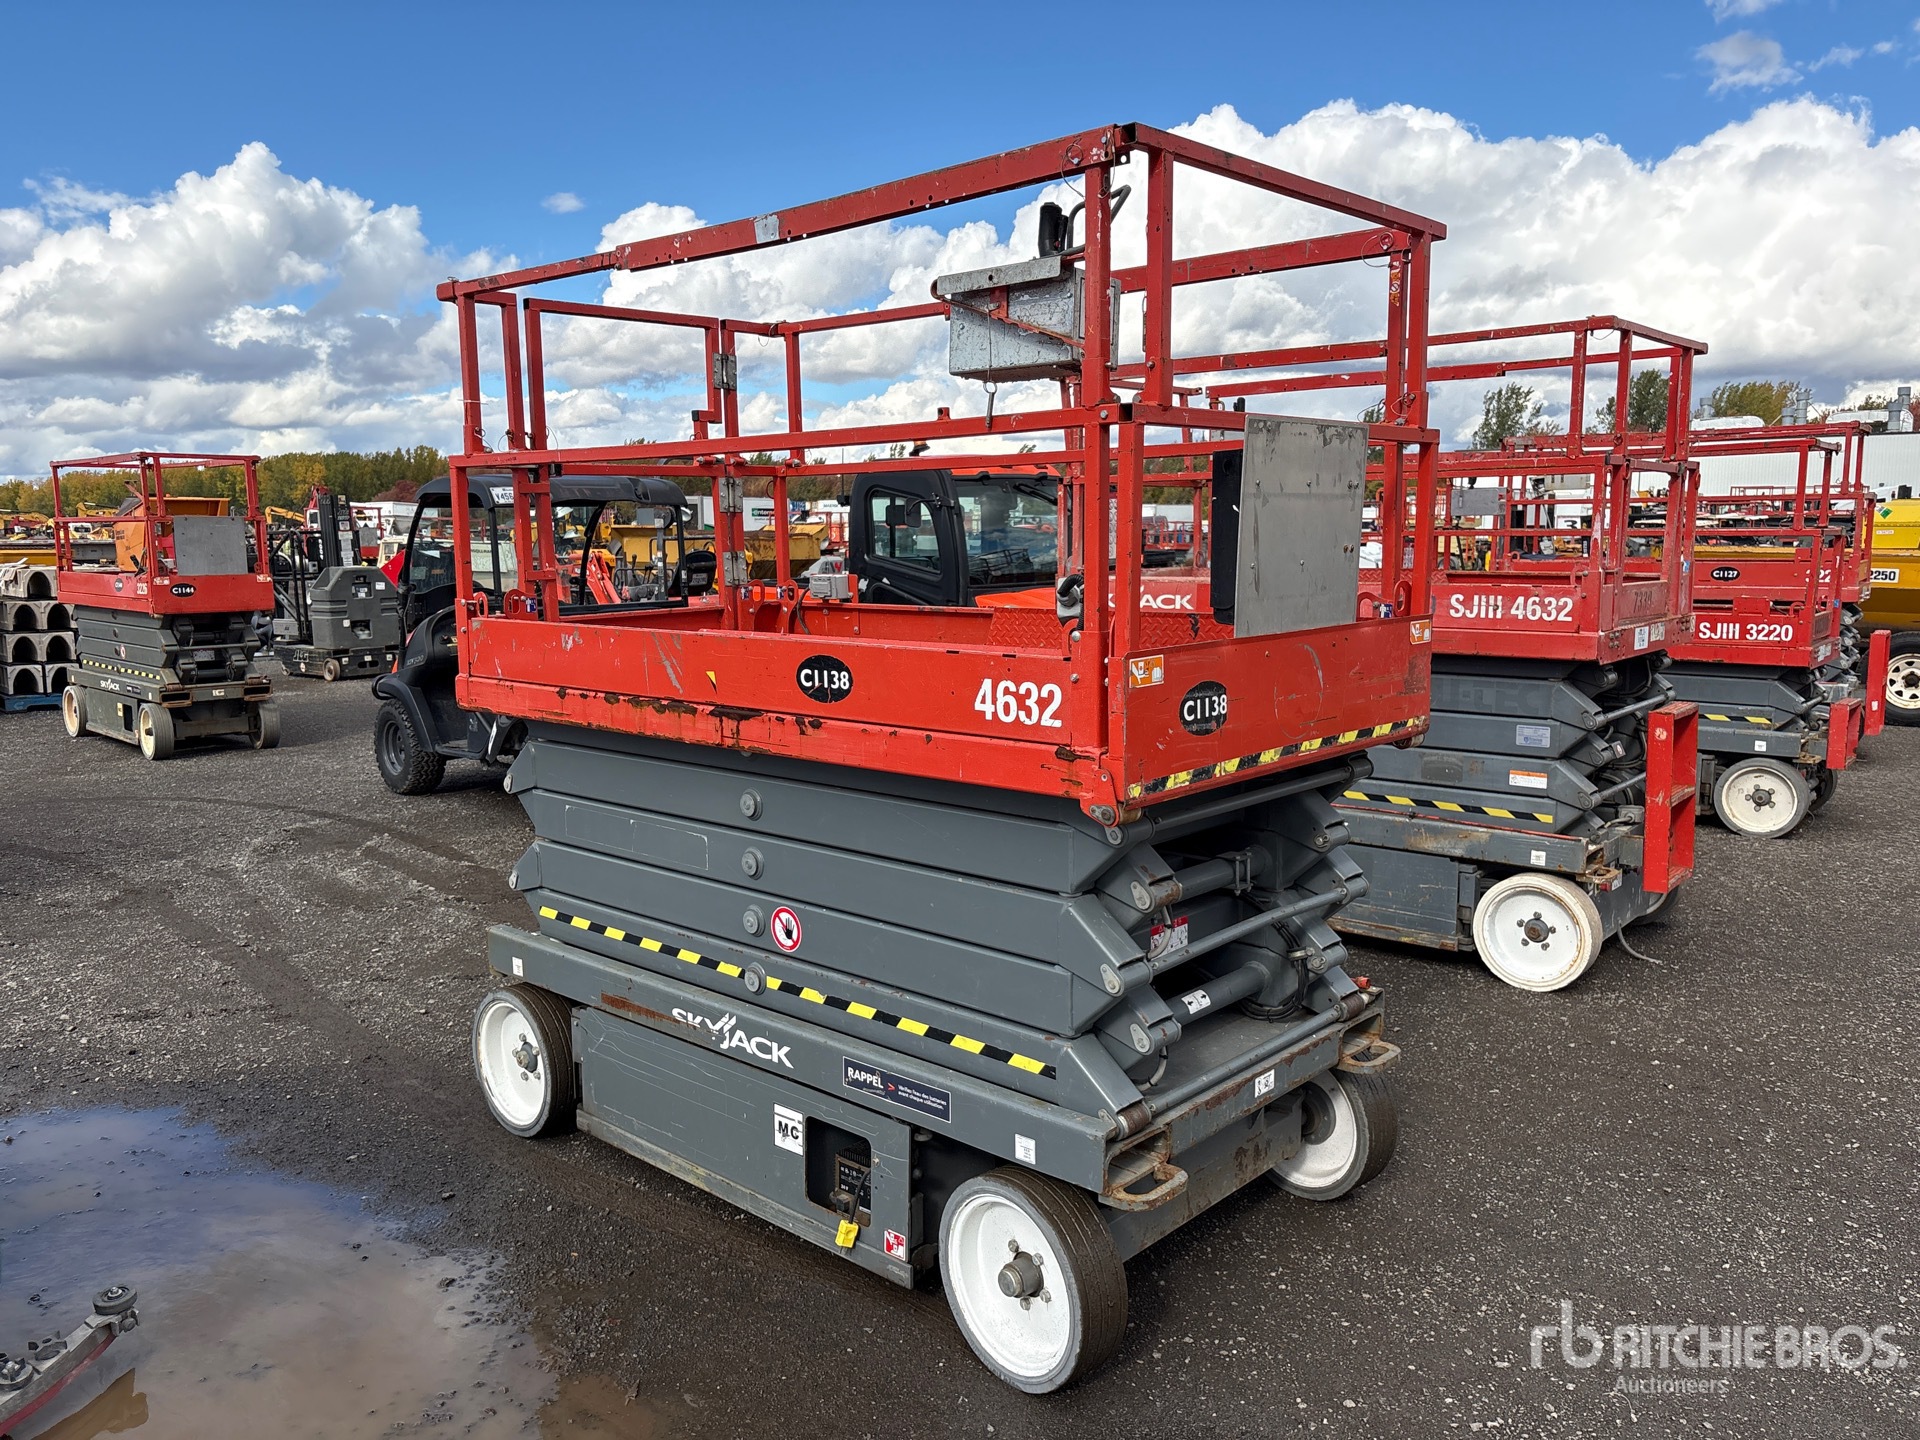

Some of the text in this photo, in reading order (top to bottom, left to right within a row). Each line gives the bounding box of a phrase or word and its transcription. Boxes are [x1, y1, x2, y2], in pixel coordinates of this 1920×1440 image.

[1713, 570, 1738, 578] C1127
[1510, 595, 1573, 622] 4632
[1698, 622, 1794, 642] SJIII 3220
[800, 668, 850, 690] C1138
[974, 678, 1063, 728] 4632
[1183, 694, 1228, 721] C1138
[671, 1007, 795, 1069] SKYJACK
[847, 1066, 884, 1089] RAPPEL
[778, 1120, 800, 1140] MC
